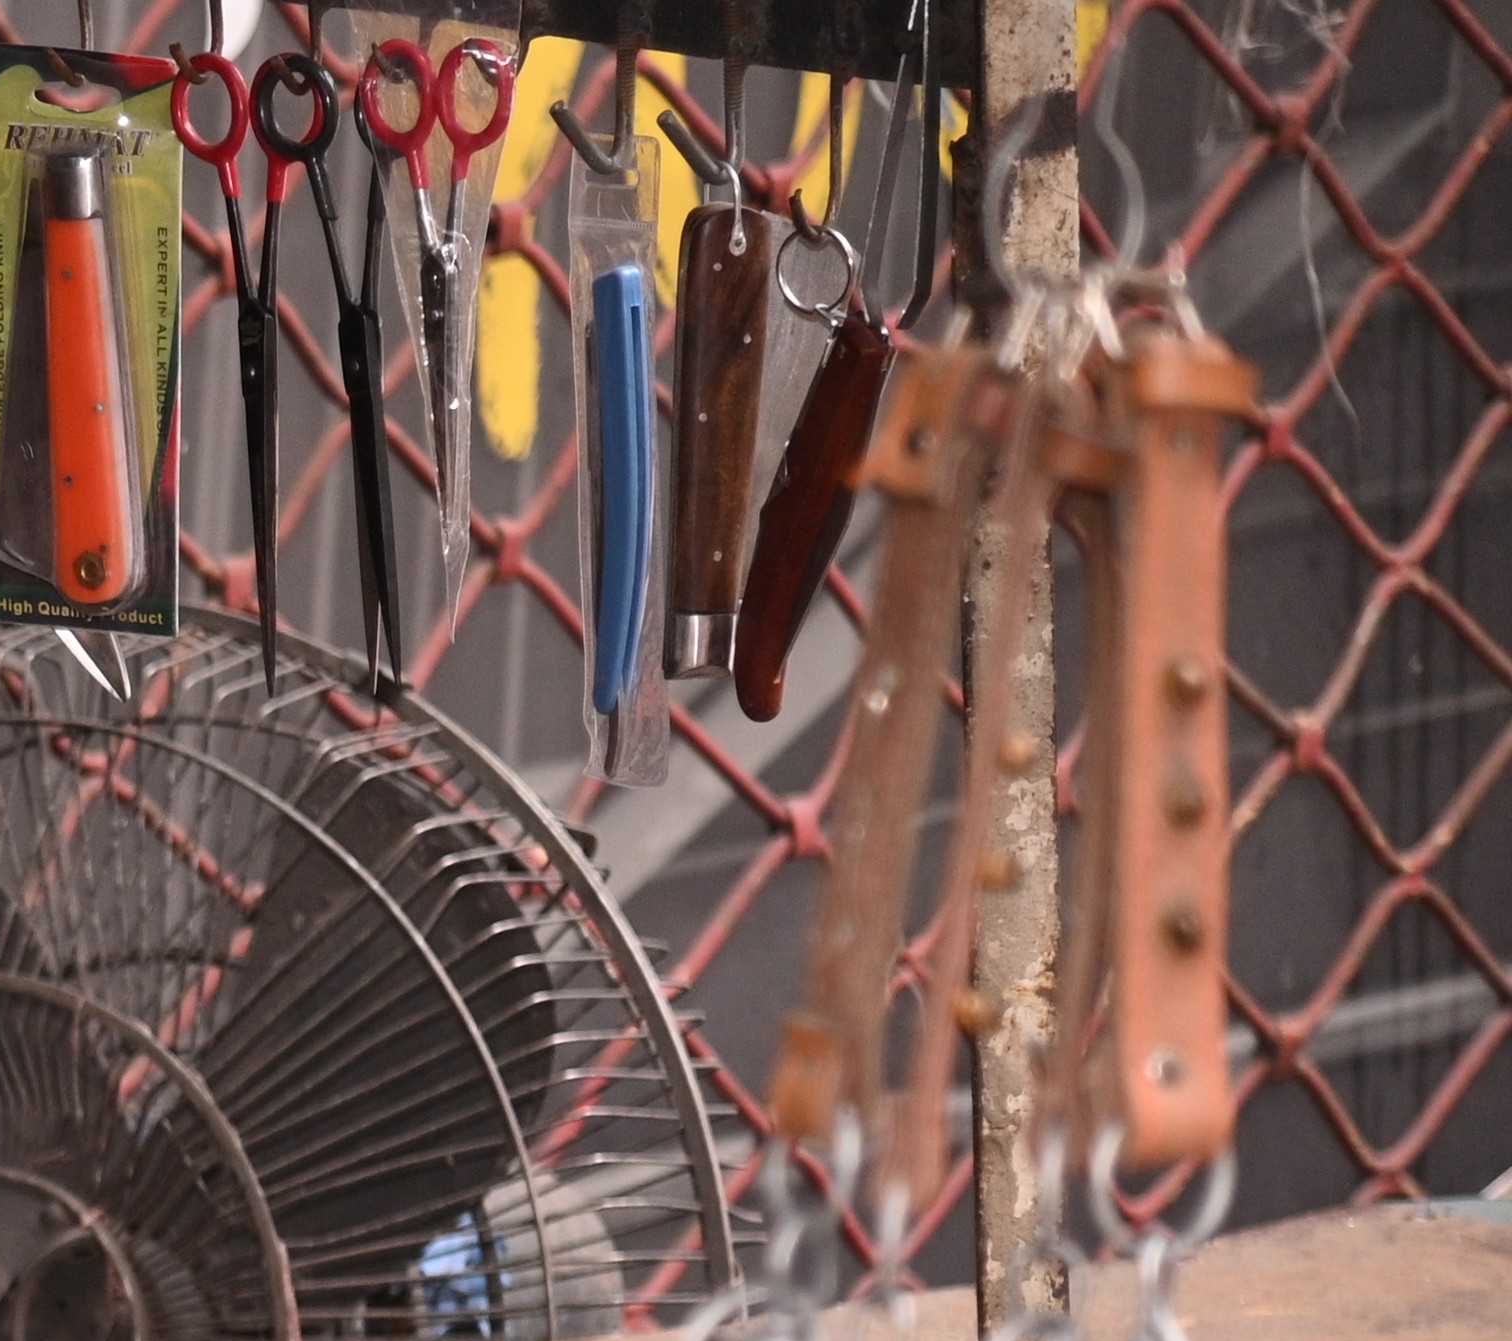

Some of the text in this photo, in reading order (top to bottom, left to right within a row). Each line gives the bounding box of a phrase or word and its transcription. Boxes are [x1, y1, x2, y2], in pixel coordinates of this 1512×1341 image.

[157, 227, 168, 296] EXPERT
[157, 324, 168, 357] ALL
[157, 362, 168, 415] KINDS
[101, 606, 163, 625] oduct
